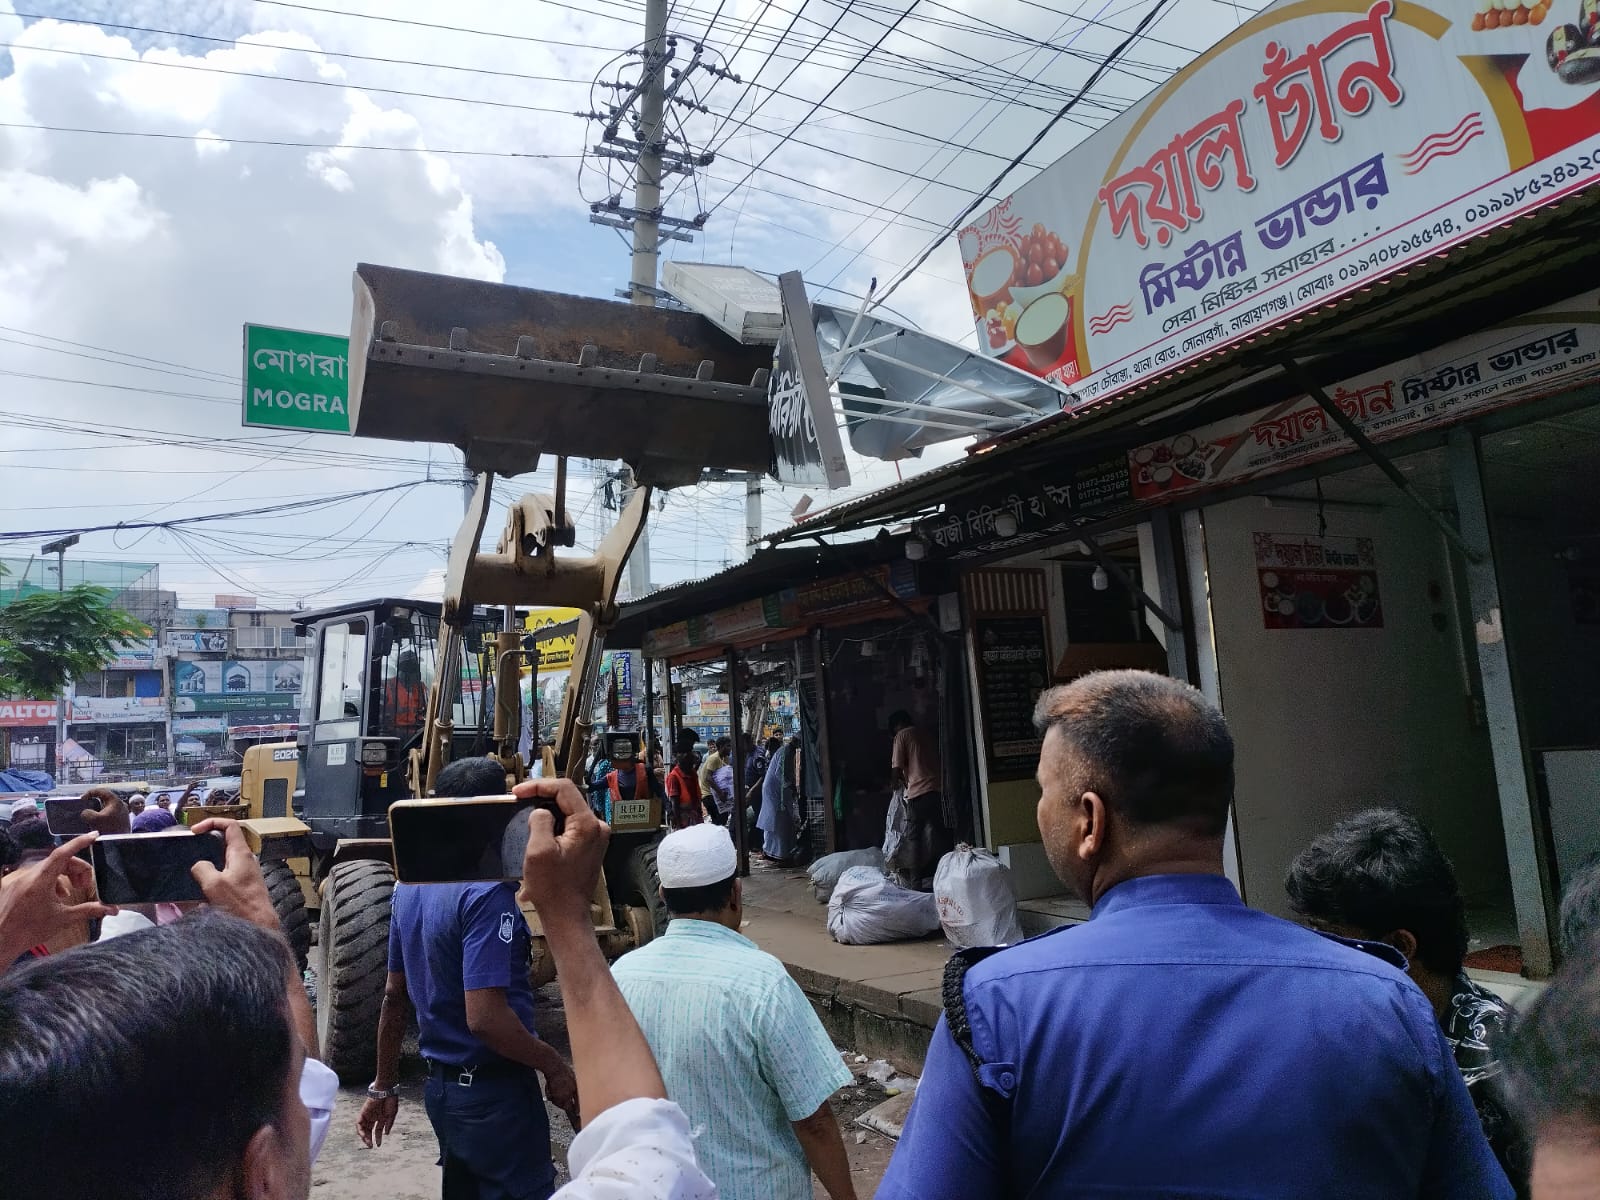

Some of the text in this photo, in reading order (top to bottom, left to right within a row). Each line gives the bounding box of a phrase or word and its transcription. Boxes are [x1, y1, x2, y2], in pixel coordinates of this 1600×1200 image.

[1098, 0, 1404, 248] দয়াল চাঁন
[1139, 152, 1389, 315] মিষ্টান্ন ভান্ডার
[1133, 357, 1151, 374] থানা
[1154, 345, 1181, 366] রোড,
[1182, 321, 1229, 353] সোনারগাঁ,
[1297, 273, 1335, 301] মোবাঃ
[1338, 218, 1461, 282] ০১৯৭০৮১৫৫৭৪,
[1162, 305, 1197, 334] সেরা
[1201, 276, 1258, 315] মিষ্টির
[253, 348, 348, 380] মোগরা
[1251, 405, 1329, 448] দয়াল
[1401, 361, 1481, 404] মিষ্টান্ন
[1487, 327, 1580, 371] ভান্ডার
[1438, 396, 1459, 410] এবং
[1462, 382, 1499, 402] সকালে
[1502, 373, 1528, 388] নাস্তা
[1530, 361, 1568, 378] পাওয়া
[253, 387, 345, 415] MOGRA
[933, 514, 964, 548] হাজী
